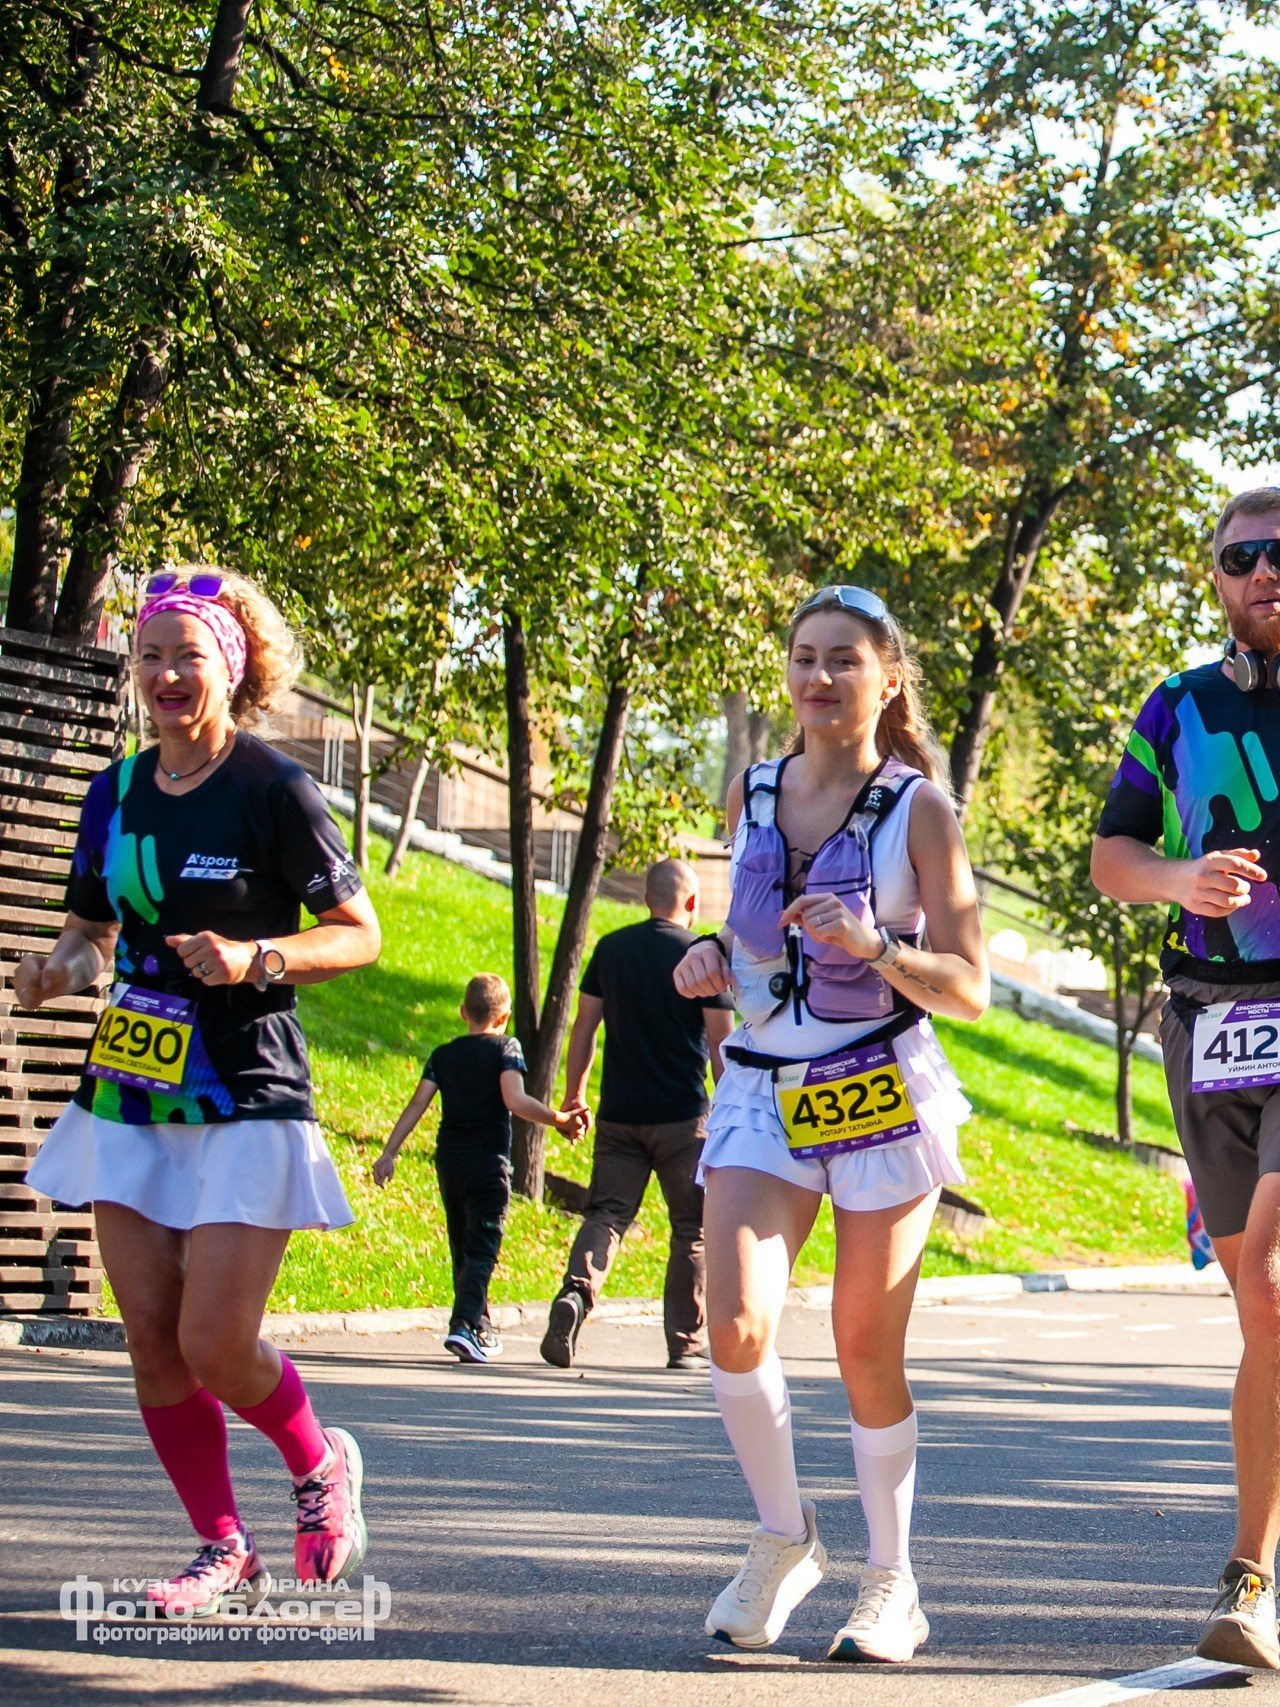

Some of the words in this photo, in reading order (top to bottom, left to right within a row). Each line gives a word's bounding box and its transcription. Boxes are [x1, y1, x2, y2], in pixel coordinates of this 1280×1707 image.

[98, 1013, 183, 1065] 4290
[1227, 1063, 1256, 1073] УЙМИН
[791, 1073, 903, 1129] 4323
[819, 1126, 847, 1138] РОТАРУ
[848, 1118, 884, 1132] ТАТЬЯНА
